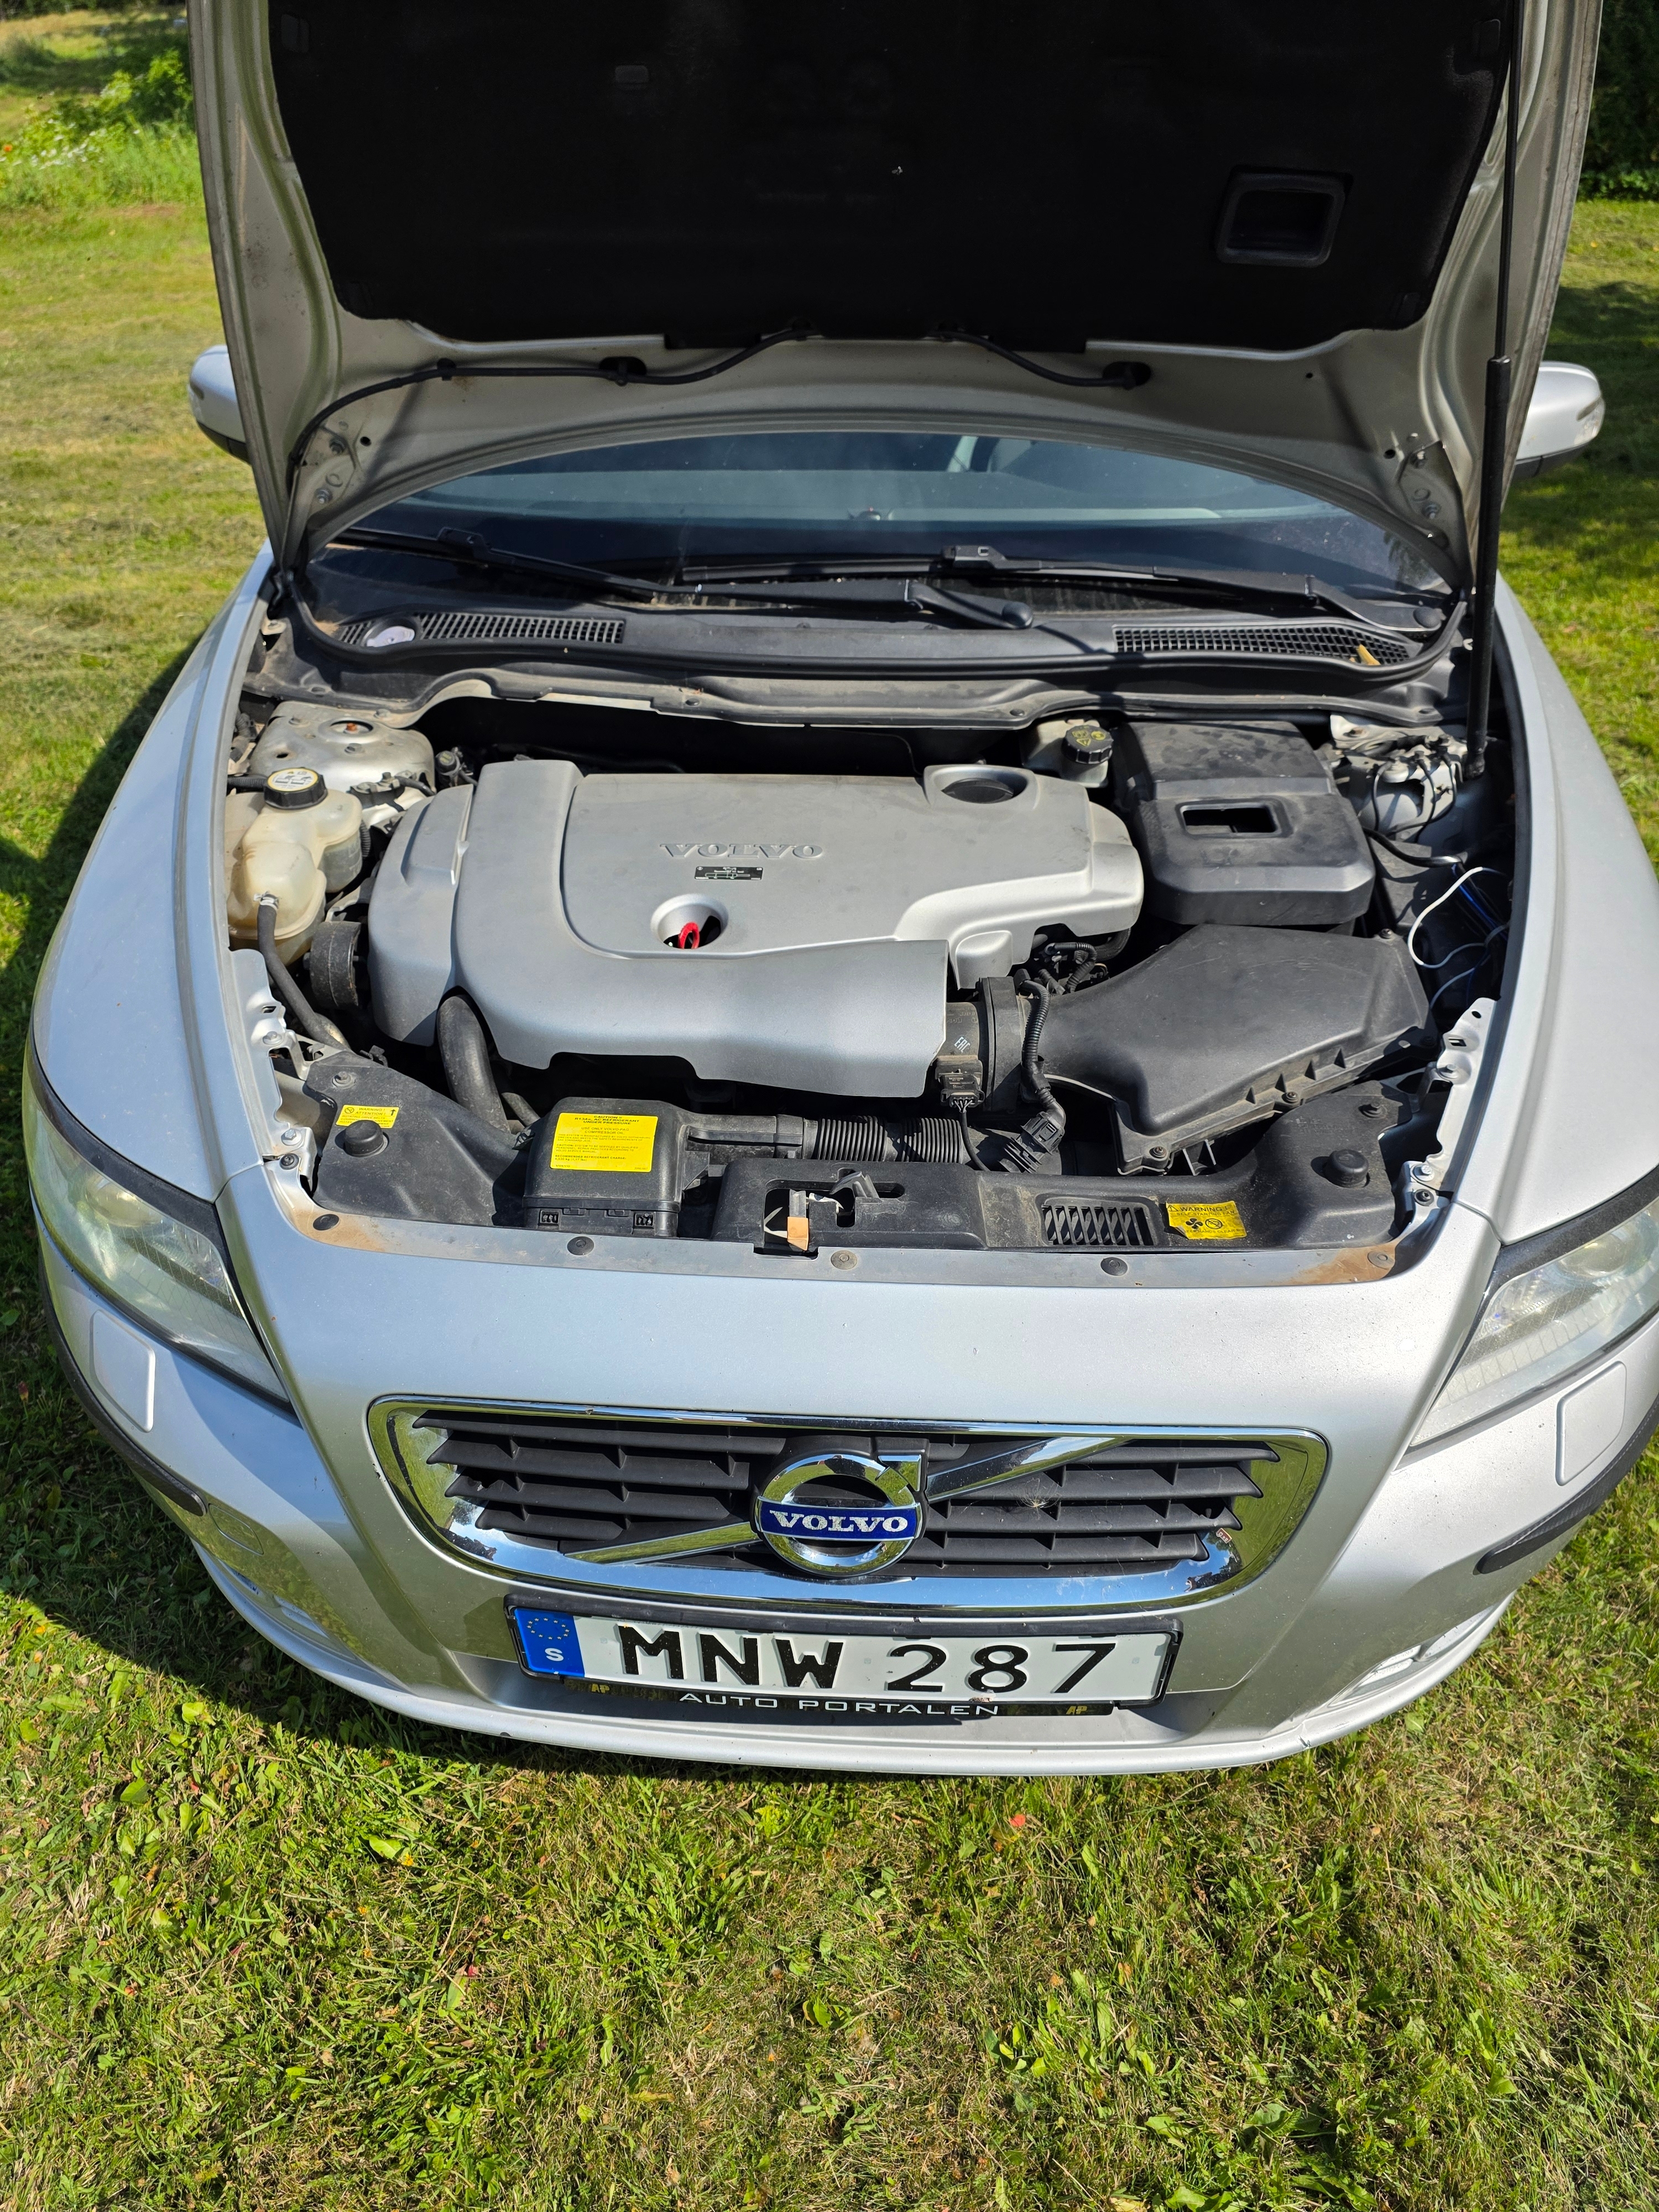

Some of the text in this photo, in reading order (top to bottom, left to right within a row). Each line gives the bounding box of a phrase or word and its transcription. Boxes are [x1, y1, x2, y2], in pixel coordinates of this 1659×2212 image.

[660, 843, 823, 858] VOLVO
[769, 1510, 908, 1532] VOLVO
[545, 1648, 564, 1661] S
[618, 1625, 1117, 1694] MNW 287
[679, 1693, 998, 1715] AUTO PORTALEN
